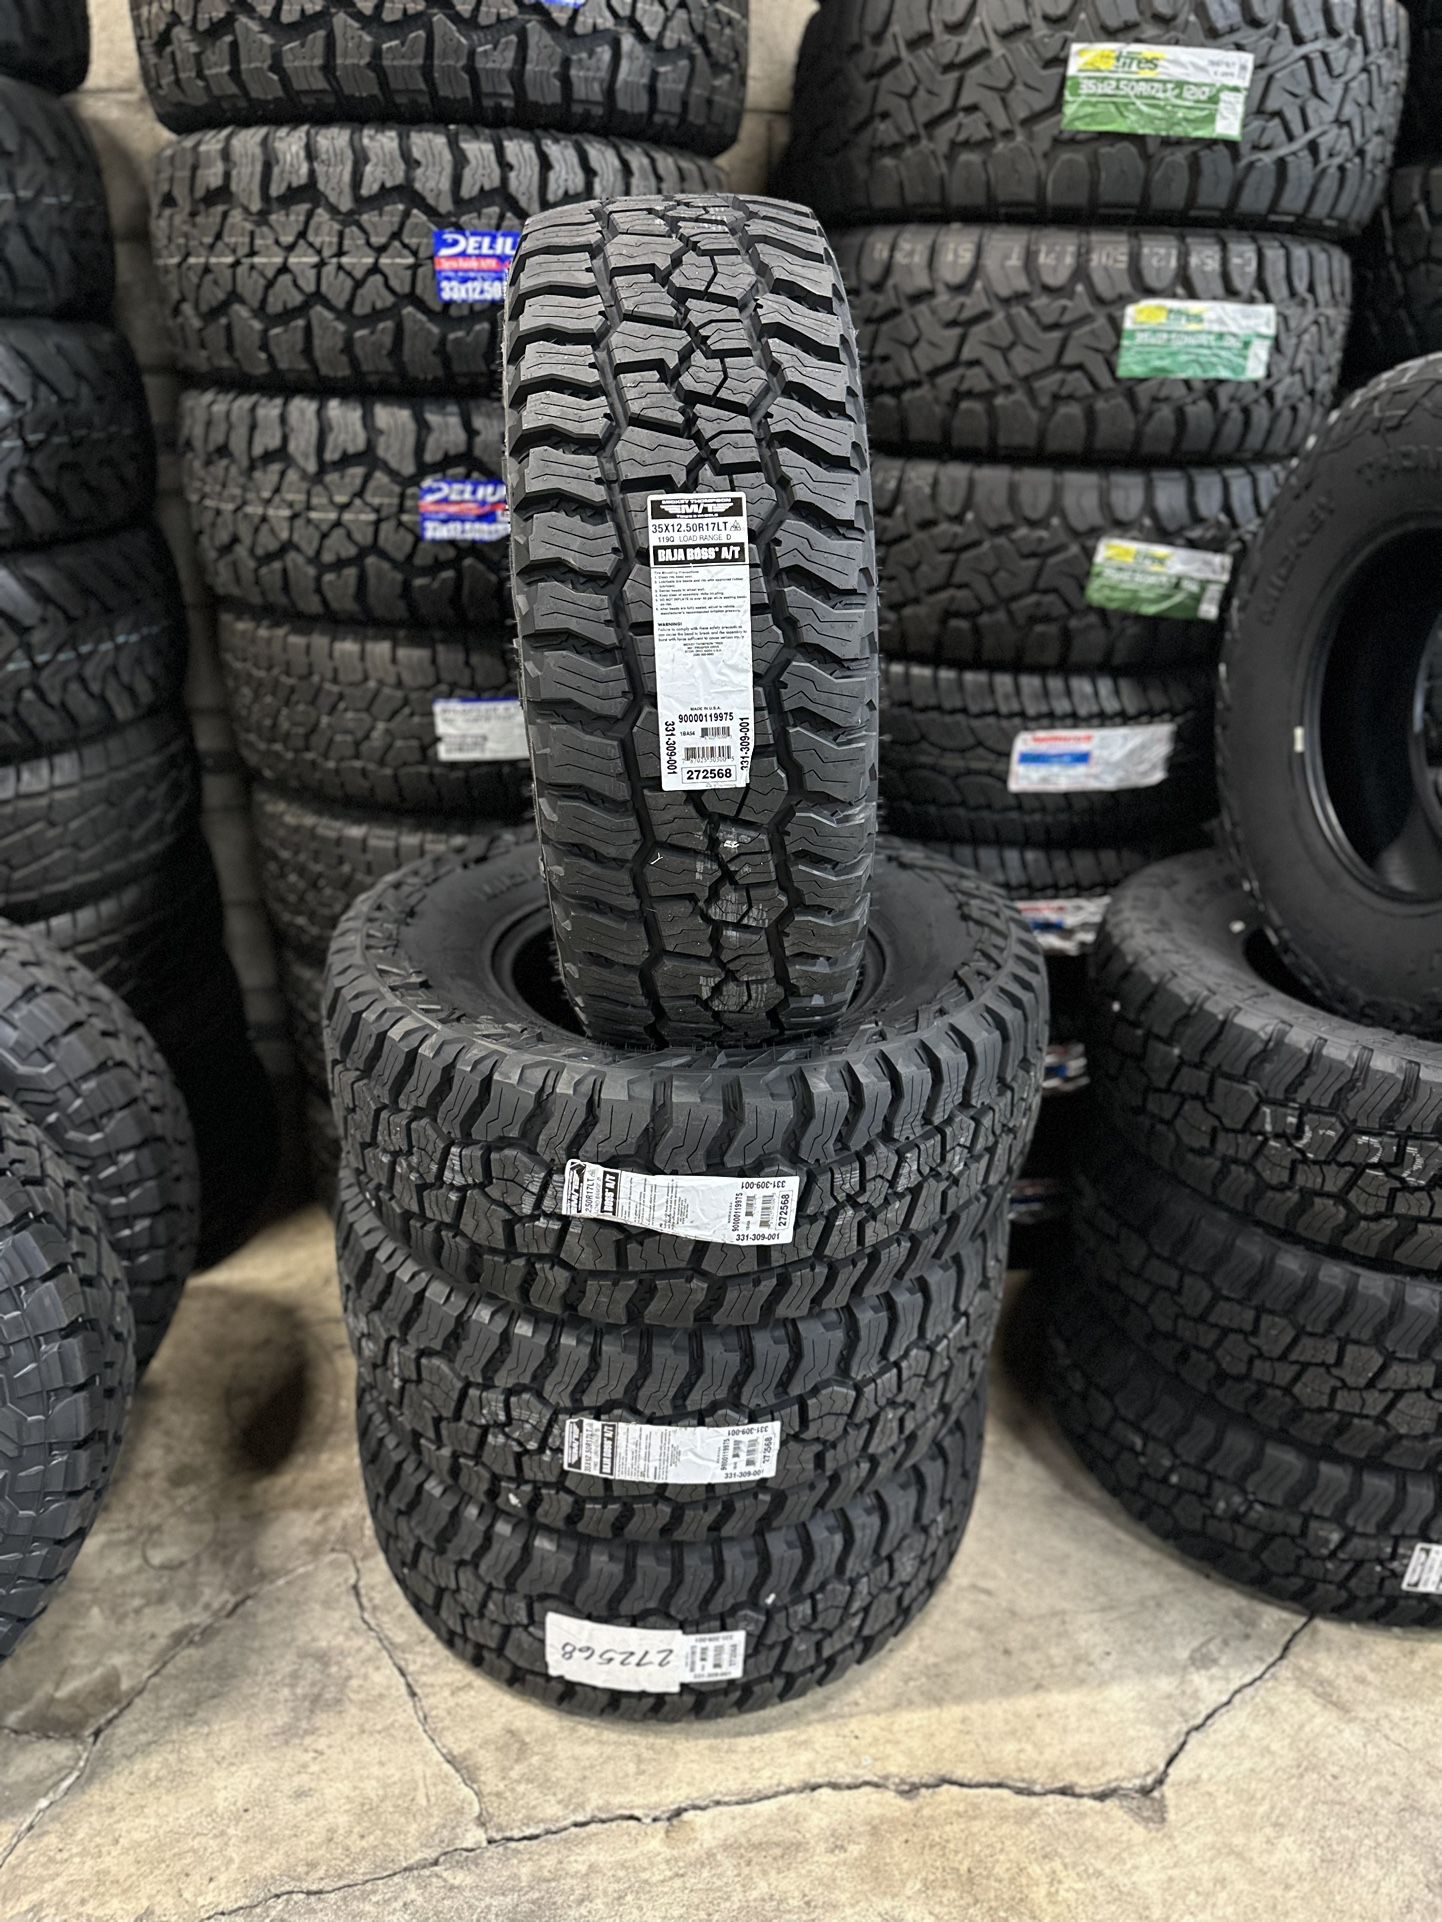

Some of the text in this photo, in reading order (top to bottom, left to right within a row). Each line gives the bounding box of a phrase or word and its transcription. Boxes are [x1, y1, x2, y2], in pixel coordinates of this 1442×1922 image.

[651, 521, 729, 534] 35X12.50R17LT
[657, 533, 732, 543] 119Q LOAD RANGE D
[657, 548, 685, 562] BAJA
[720, 545, 741, 560] A/T
[678, 711, 734, 723] 90000119975
[665, 720, 678, 775] 331-309-001
[739, 716, 750, 771] 331-309-001
[686, 767, 732, 781] 272568
[604, 1173, 617, 1189] A/T
[741, 1180, 787, 1190] 331-309-001
[732, 1192, 743, 1232] 90000119975
[778, 1193, 790, 1227] 272568
[735, 1232, 780, 1242] 331-309-001
[727, 1425, 769, 1437] 331-309-001
[561, 1641, 675, 1667] 272568
